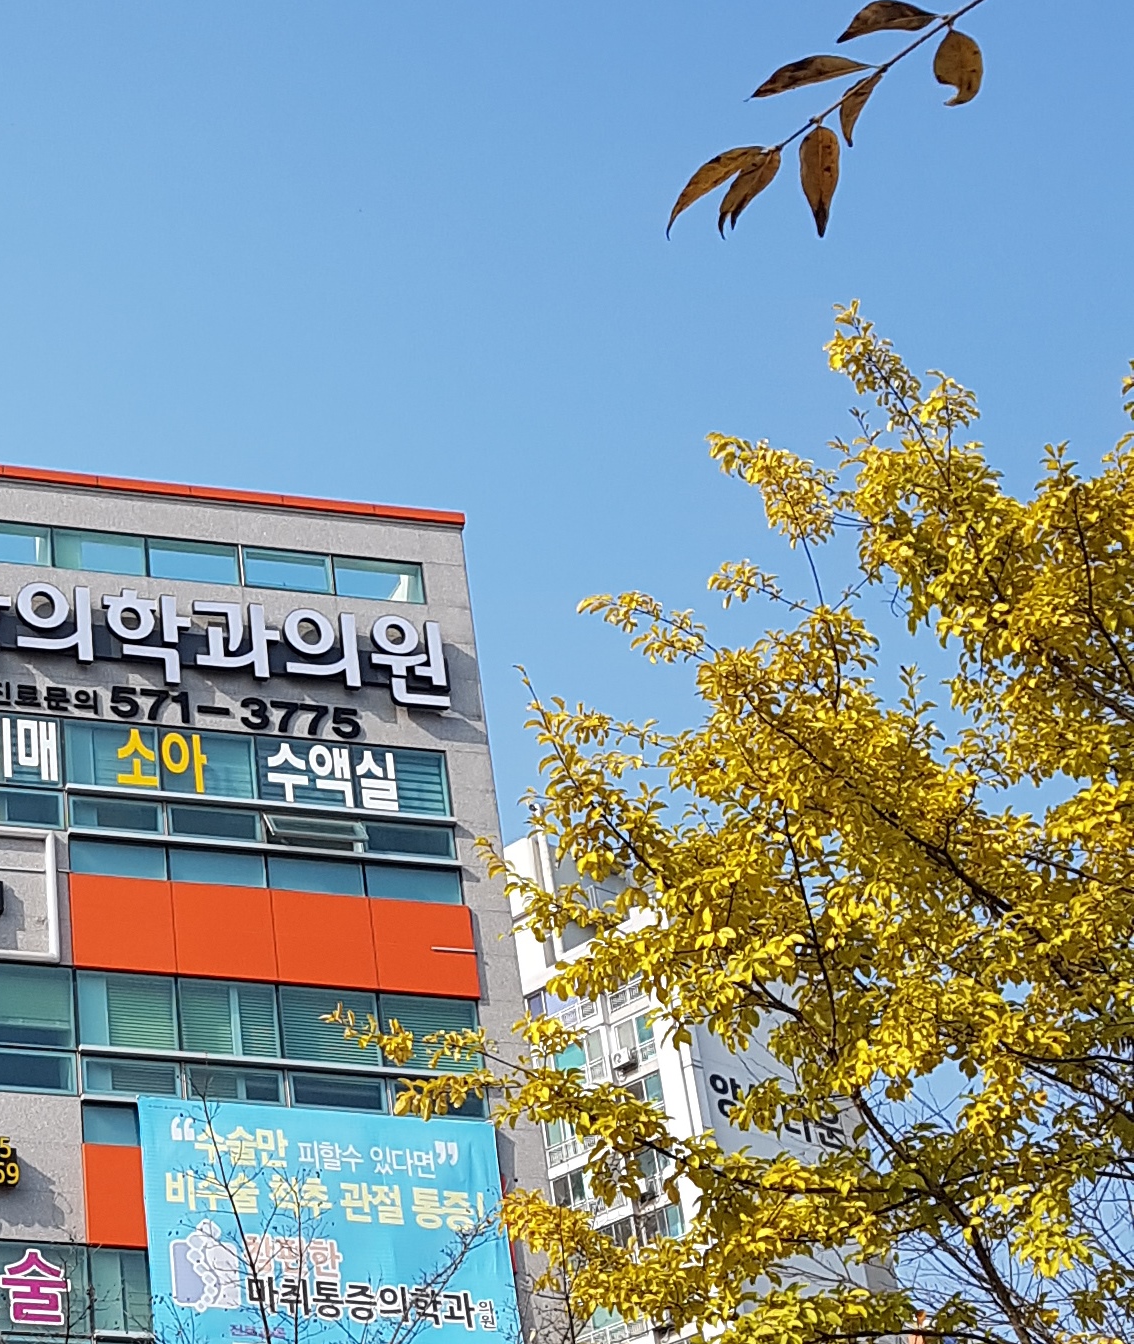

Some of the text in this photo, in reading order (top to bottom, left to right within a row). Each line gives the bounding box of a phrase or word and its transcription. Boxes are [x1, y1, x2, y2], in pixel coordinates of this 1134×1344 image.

[110, 684, 362, 739] 571-3775
[116, 728, 207, 794] 소아
[266, 742, 399, 812] 수액실
[297, 1140, 365, 1173] 피할수
[164, 1169, 260, 1214] 비수술
[268, 1171, 333, 1217] 척추
[339, 1182, 406, 1226] 관절
